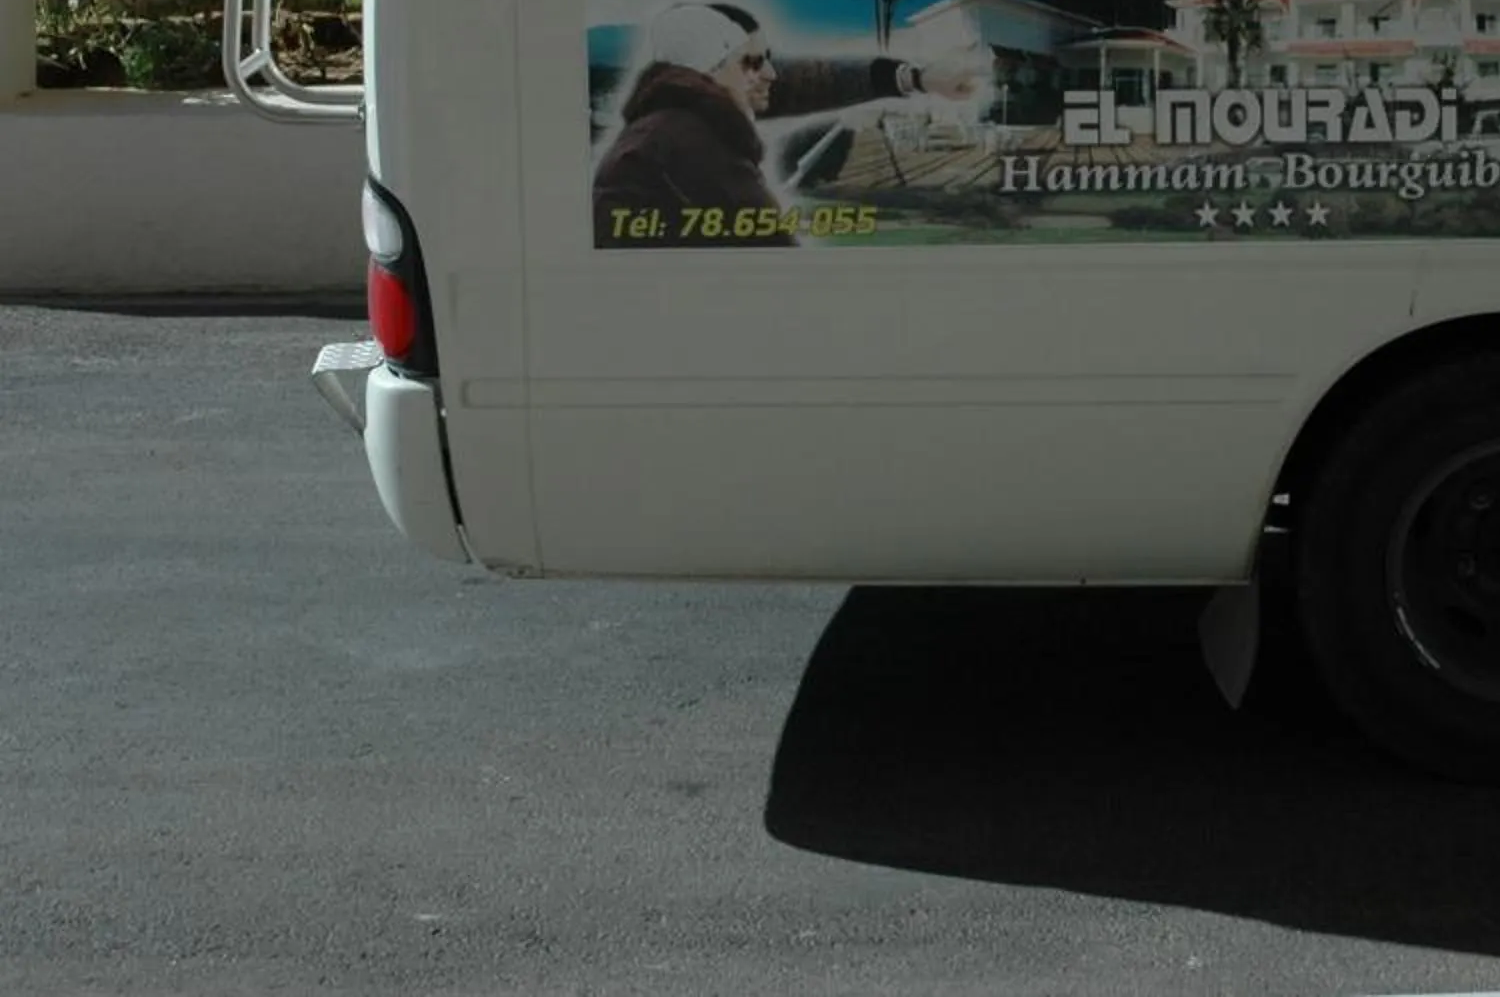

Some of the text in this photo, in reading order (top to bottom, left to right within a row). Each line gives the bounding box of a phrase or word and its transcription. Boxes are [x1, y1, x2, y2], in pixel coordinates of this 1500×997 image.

[1062, 89, 1132, 145] EL
[999, 154, 1248, 192] Hammam
[609, 206, 667, 238] Tél:
